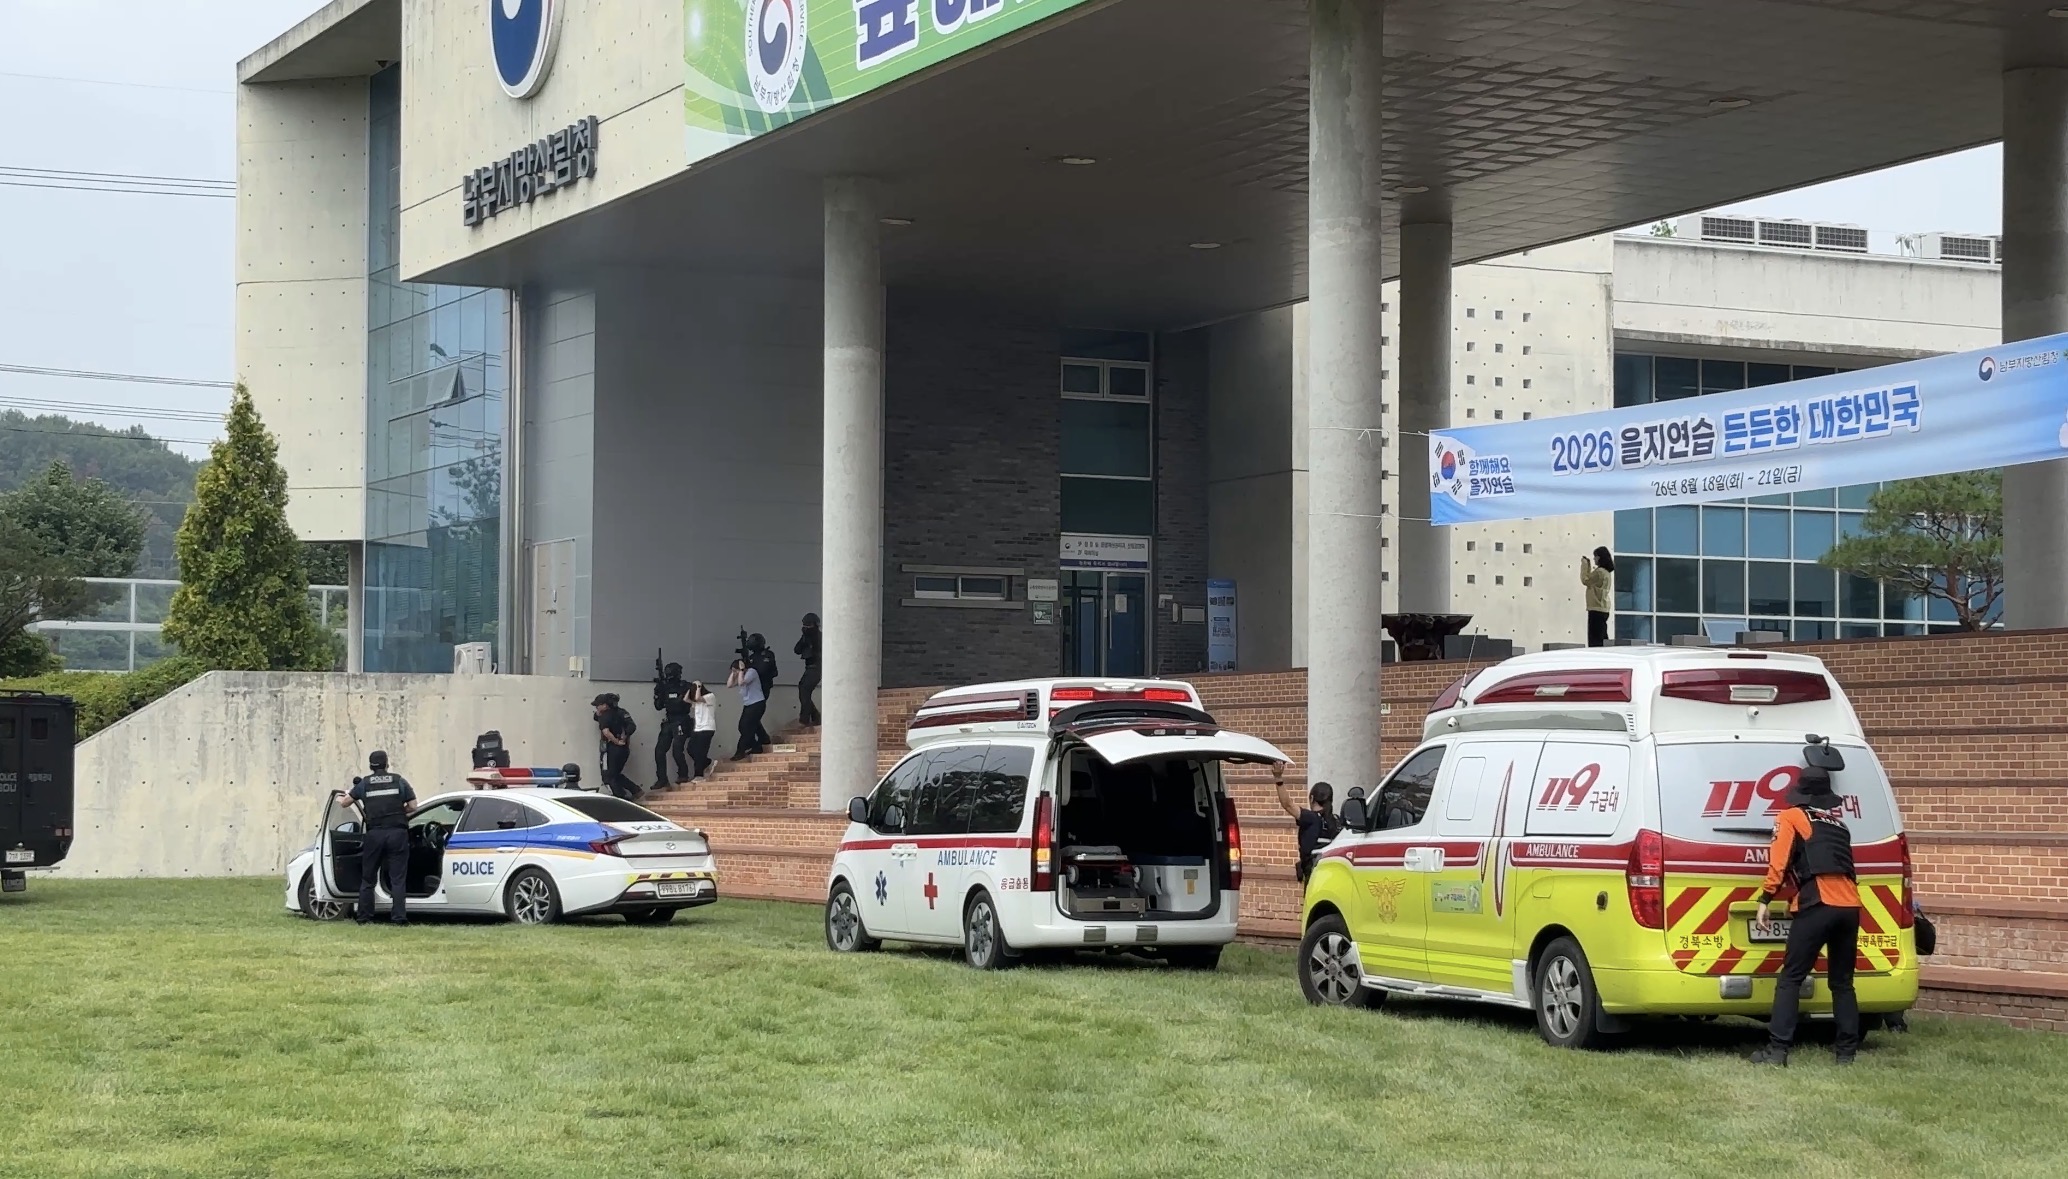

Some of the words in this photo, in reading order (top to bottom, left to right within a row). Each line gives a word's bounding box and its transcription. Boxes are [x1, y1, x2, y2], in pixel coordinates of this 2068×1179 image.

[753, 57, 800, 106] 남부지방산림청
[463, 115, 599, 227] 남부지방산림청
[2000, 351, 2059, 372] 남부지방산림청
[1552, 430, 1614, 472] 2026
[1621, 417, 1716, 465] 을지연습
[1724, 404, 1801, 453] 든든한
[1808, 385, 1920, 440] 대한민국
[1469, 457, 1511, 476] 함께해요
[1470, 476, 1515, 496] 을지연습
[1680, 477, 1698, 495] 8월
[1702, 471, 1744, 492] 18일(화)
[1757, 465, 1802, 486] 21일(금)
[1537, 763, 1601, 811] 119
[1590, 786, 1619, 812] 구급대
[1701, 766, 1803, 817] 119
[938, 850, 998, 866] AMBULANCE
[1526, 844, 1580, 858] AMBULANCE
[452, 861, 495, 875] POLICE
[1679, 935, 1724, 949] 경북소방
